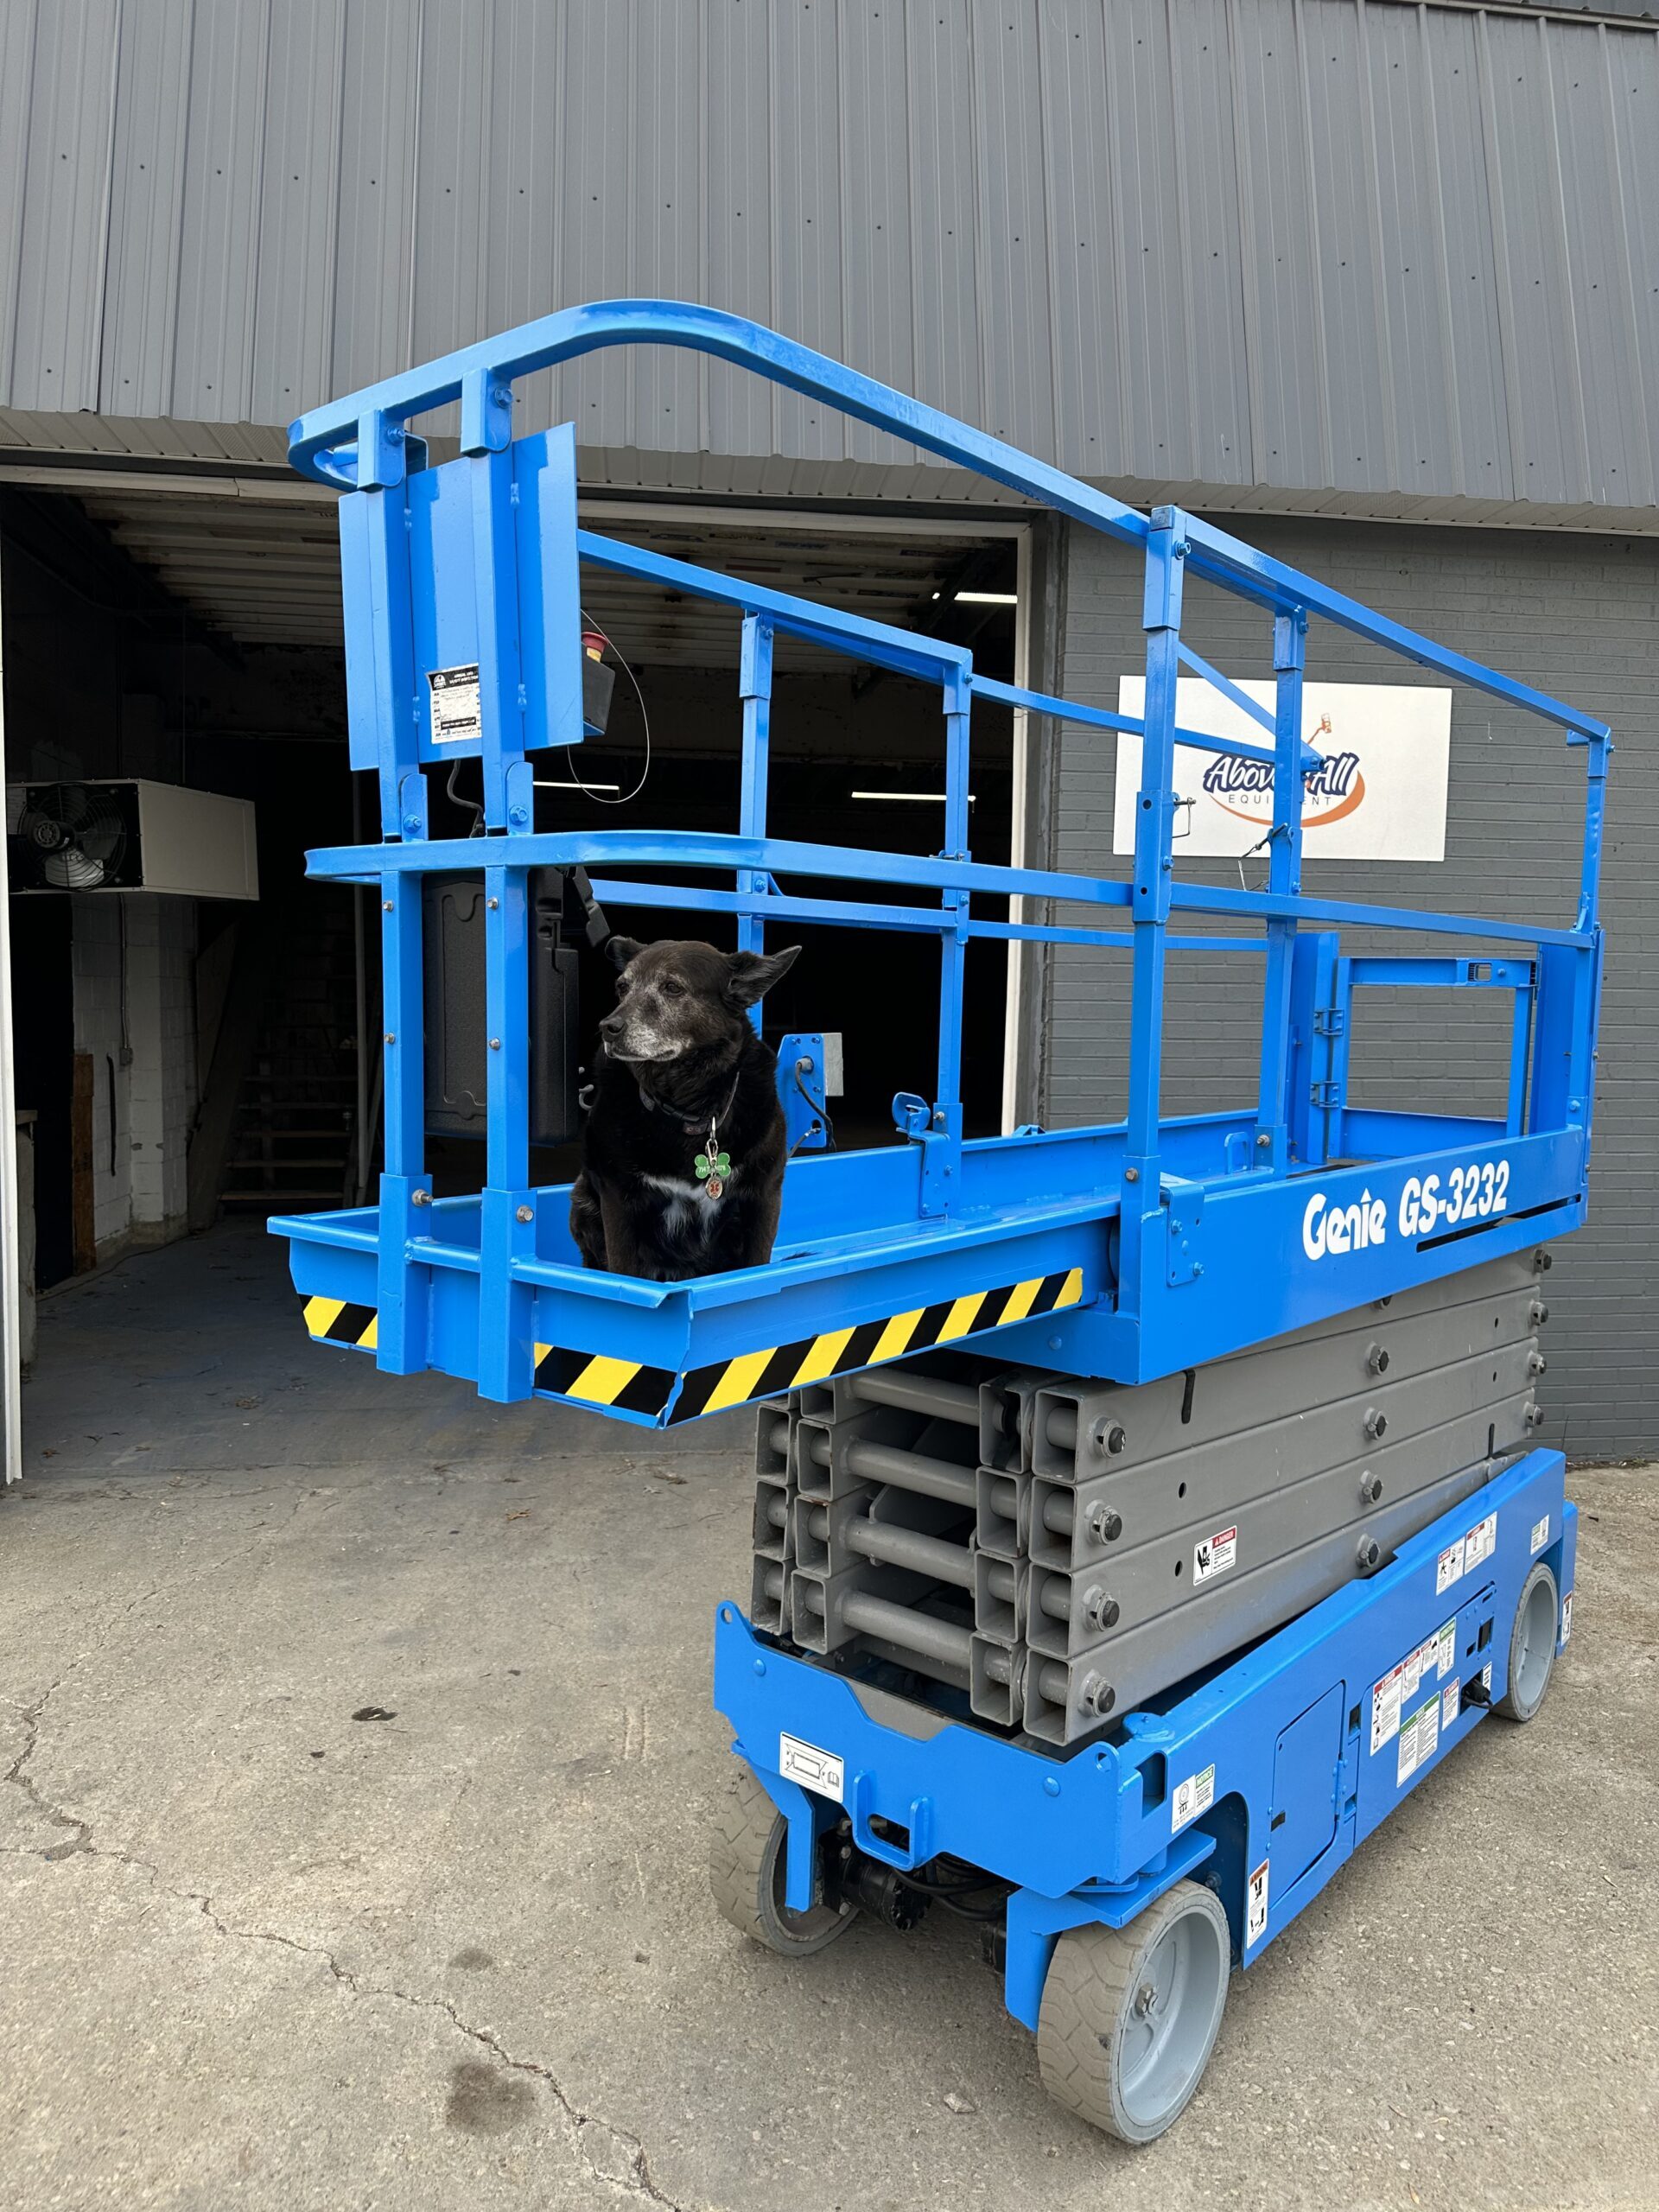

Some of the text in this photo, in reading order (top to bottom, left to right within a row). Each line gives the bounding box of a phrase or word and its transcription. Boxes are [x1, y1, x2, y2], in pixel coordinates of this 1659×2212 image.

[1203, 752, 1360, 796] Abov All
[1303, 1160, 1510, 1261] Genie GS-3232
[1196, 1767, 1213, 1786] NOTICE
